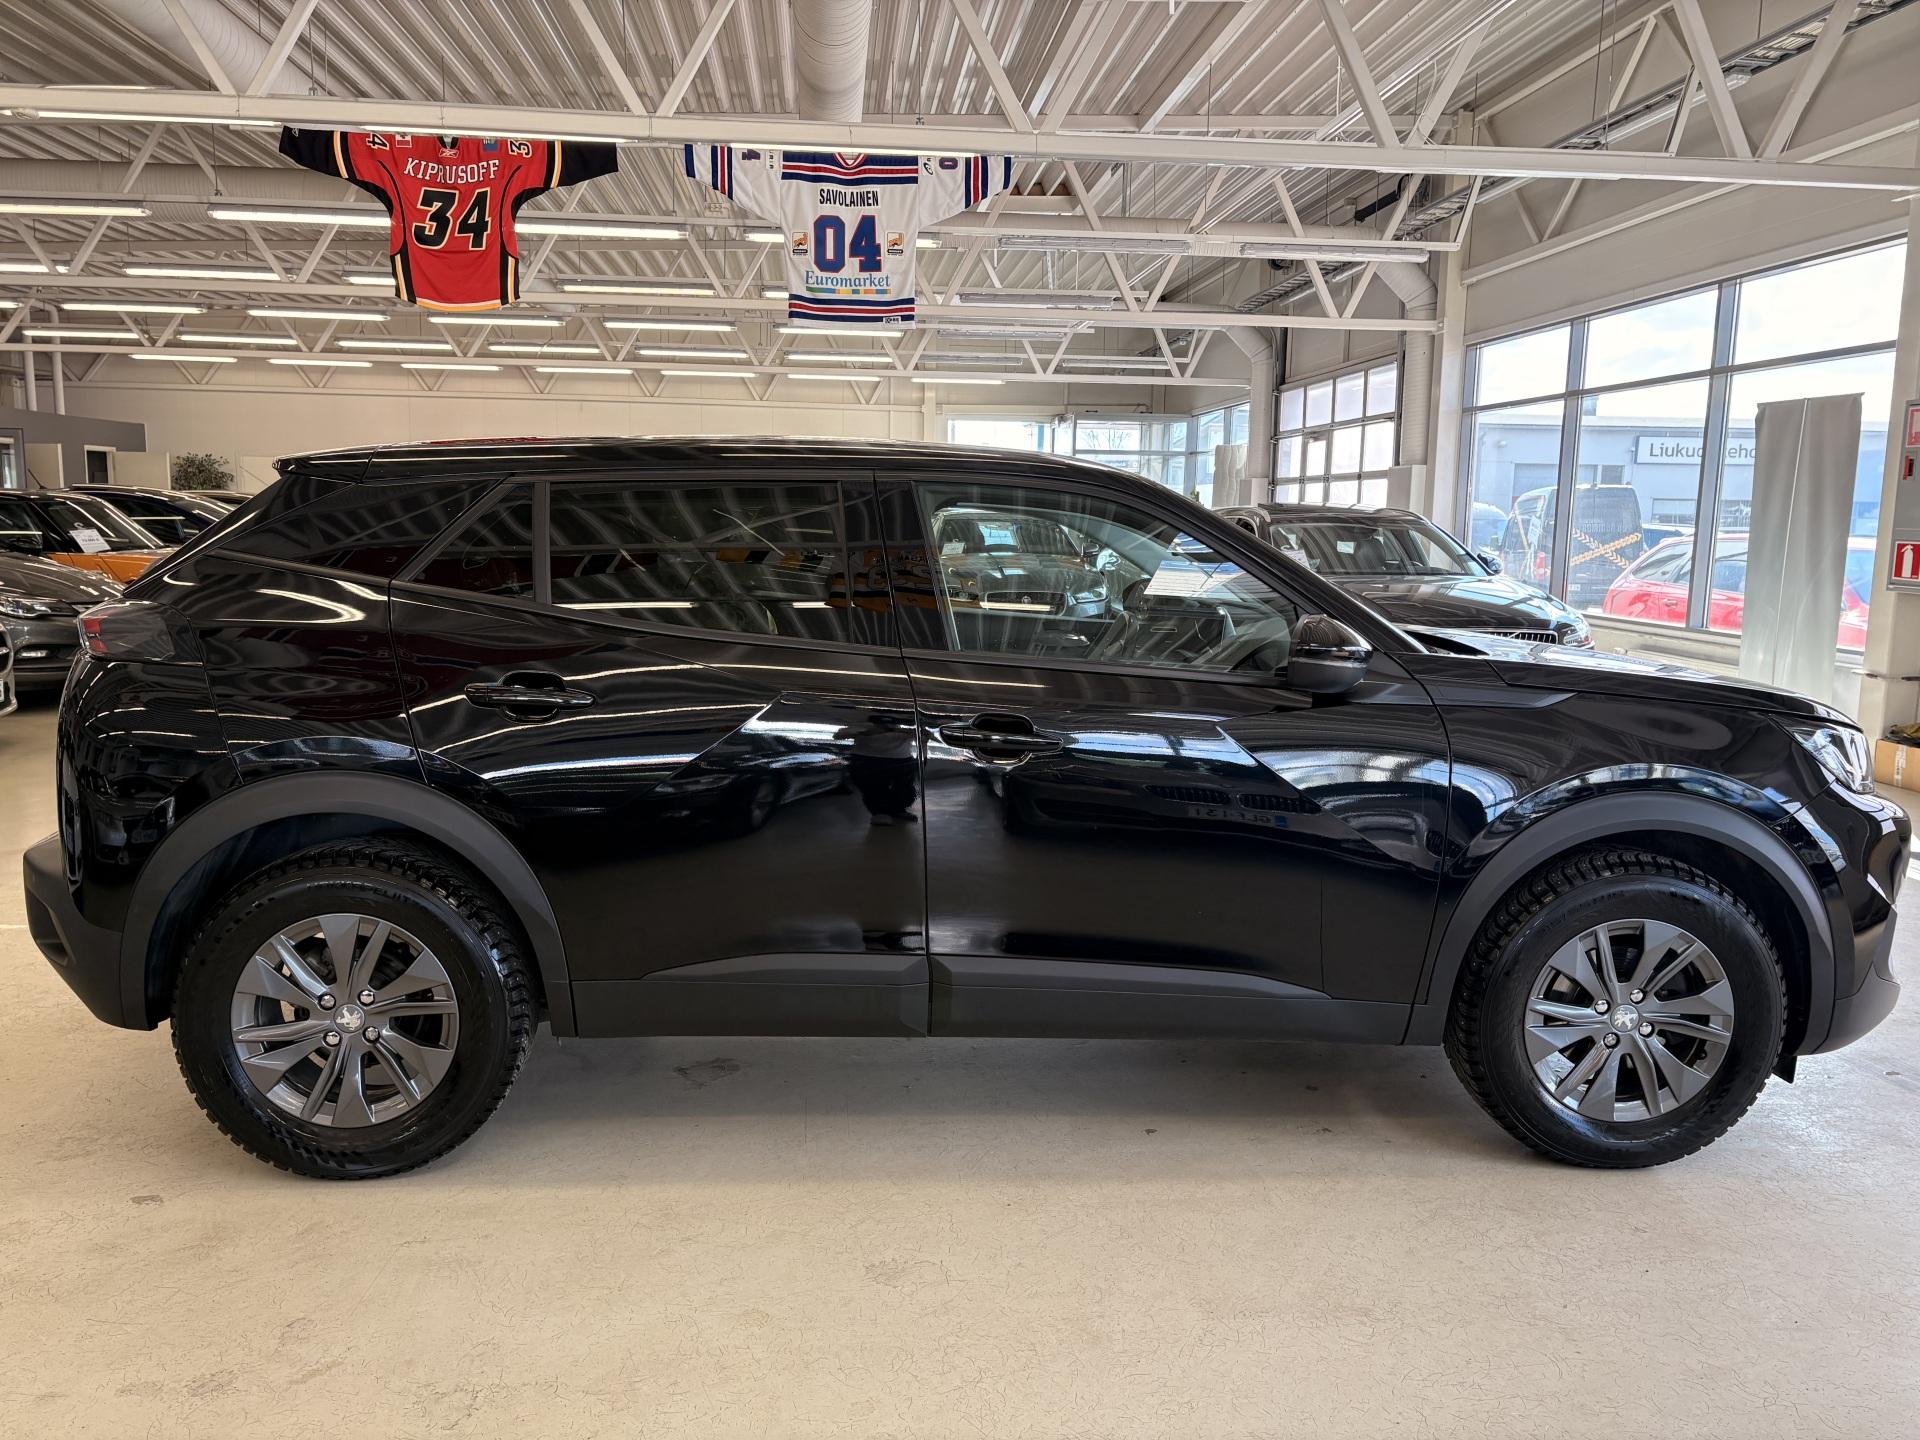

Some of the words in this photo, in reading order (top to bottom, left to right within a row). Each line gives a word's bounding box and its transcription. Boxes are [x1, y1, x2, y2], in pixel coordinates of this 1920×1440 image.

[403, 157, 500, 184] KIPRUSOFF
[819, 188, 879, 207] SAVOLAINEN
[412, 186, 491, 251] 34
[813, 214, 882, 273] 04
[805, 270, 891, 288] Euromarket
